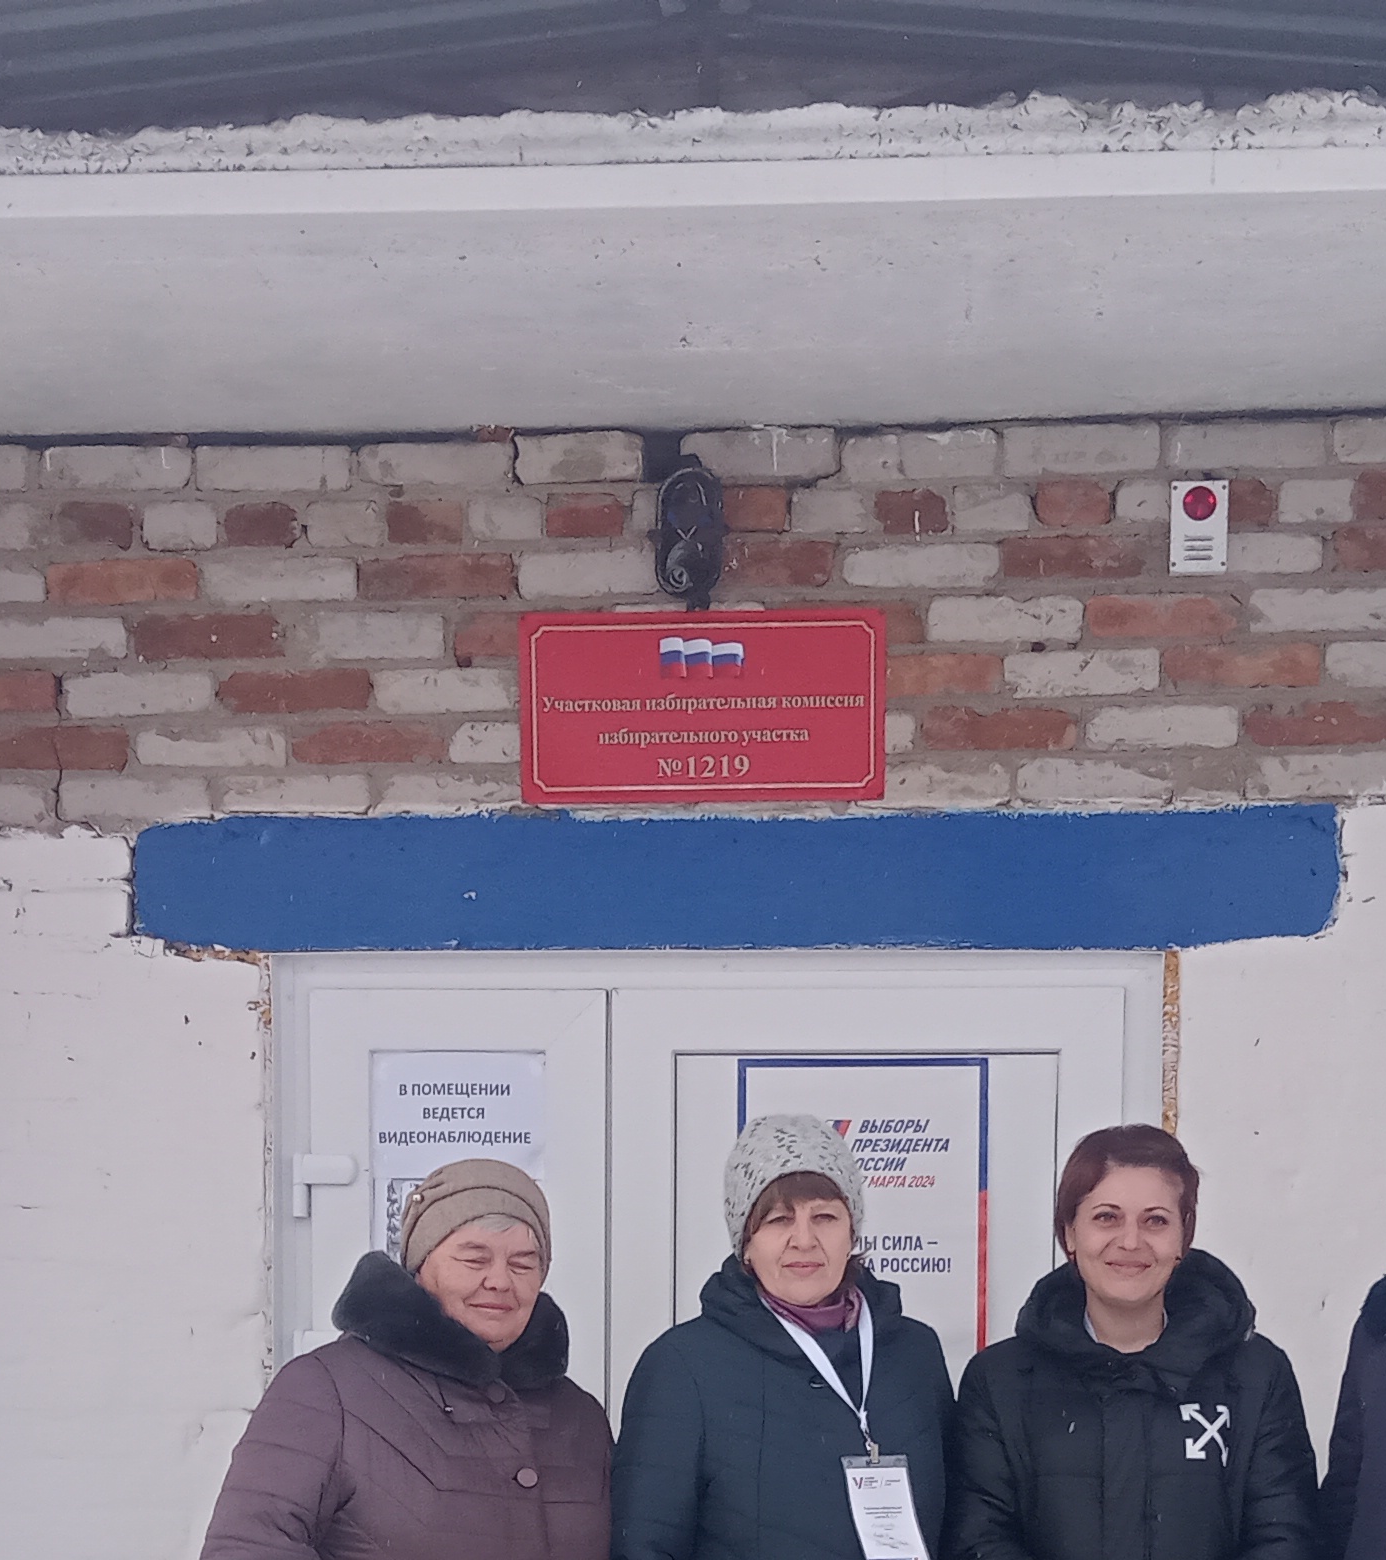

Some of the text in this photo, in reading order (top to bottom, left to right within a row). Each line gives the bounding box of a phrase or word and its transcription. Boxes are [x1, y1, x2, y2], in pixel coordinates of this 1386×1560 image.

[542, 694, 865, 715] Участковая избирательная комиссия
[598, 727, 810, 748] избирательного участка
[399, 1083, 511, 1098] В ПОМЕЩЕНИИ
[422, 1107, 486, 1122] ВЕДЕТСЯ
[858, 1119, 931, 1134] ВЫБОРЫ
[378, 1131, 532, 1146] ВИДЕОНАБЛЮДЕНИЕ
[850, 1138, 950, 1155] ПРЕЗИДЕНТА
[855, 1157, 908, 1172] ОССИИ
[868, 1175, 908, 1188] МАРТА
[908, 1175, 936, 1188] 2024
[882, 1236, 924, 1251] СИЛА
[881, 1257, 951, 1273] РОССИЮ!
